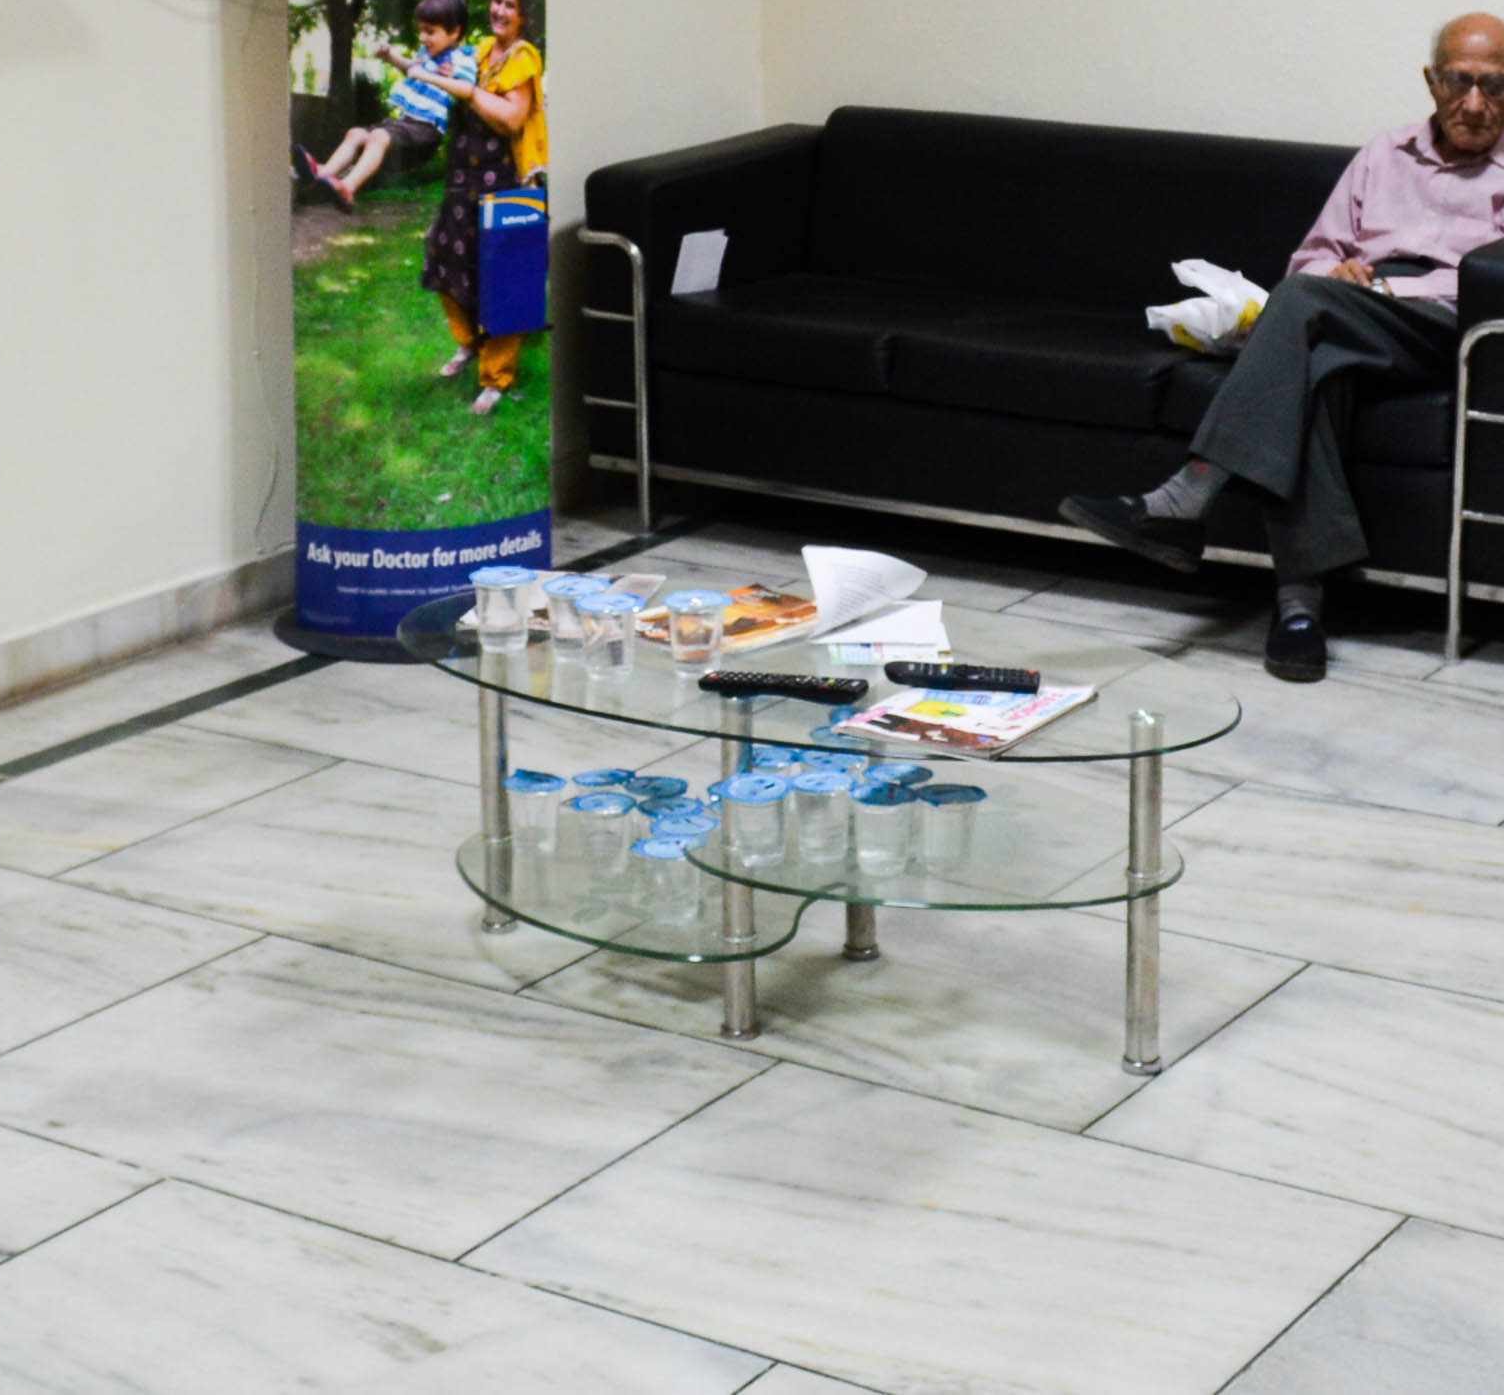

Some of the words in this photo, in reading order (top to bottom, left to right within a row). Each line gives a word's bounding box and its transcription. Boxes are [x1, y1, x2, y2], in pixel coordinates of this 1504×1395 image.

[307, 542, 330, 565] Ask
[333, 547, 369, 570] your
[372, 547, 429, 569] Doctor
[432, 545, 455, 567] for
[459, 542, 496, 564] more
[499, 529, 543, 557] details
